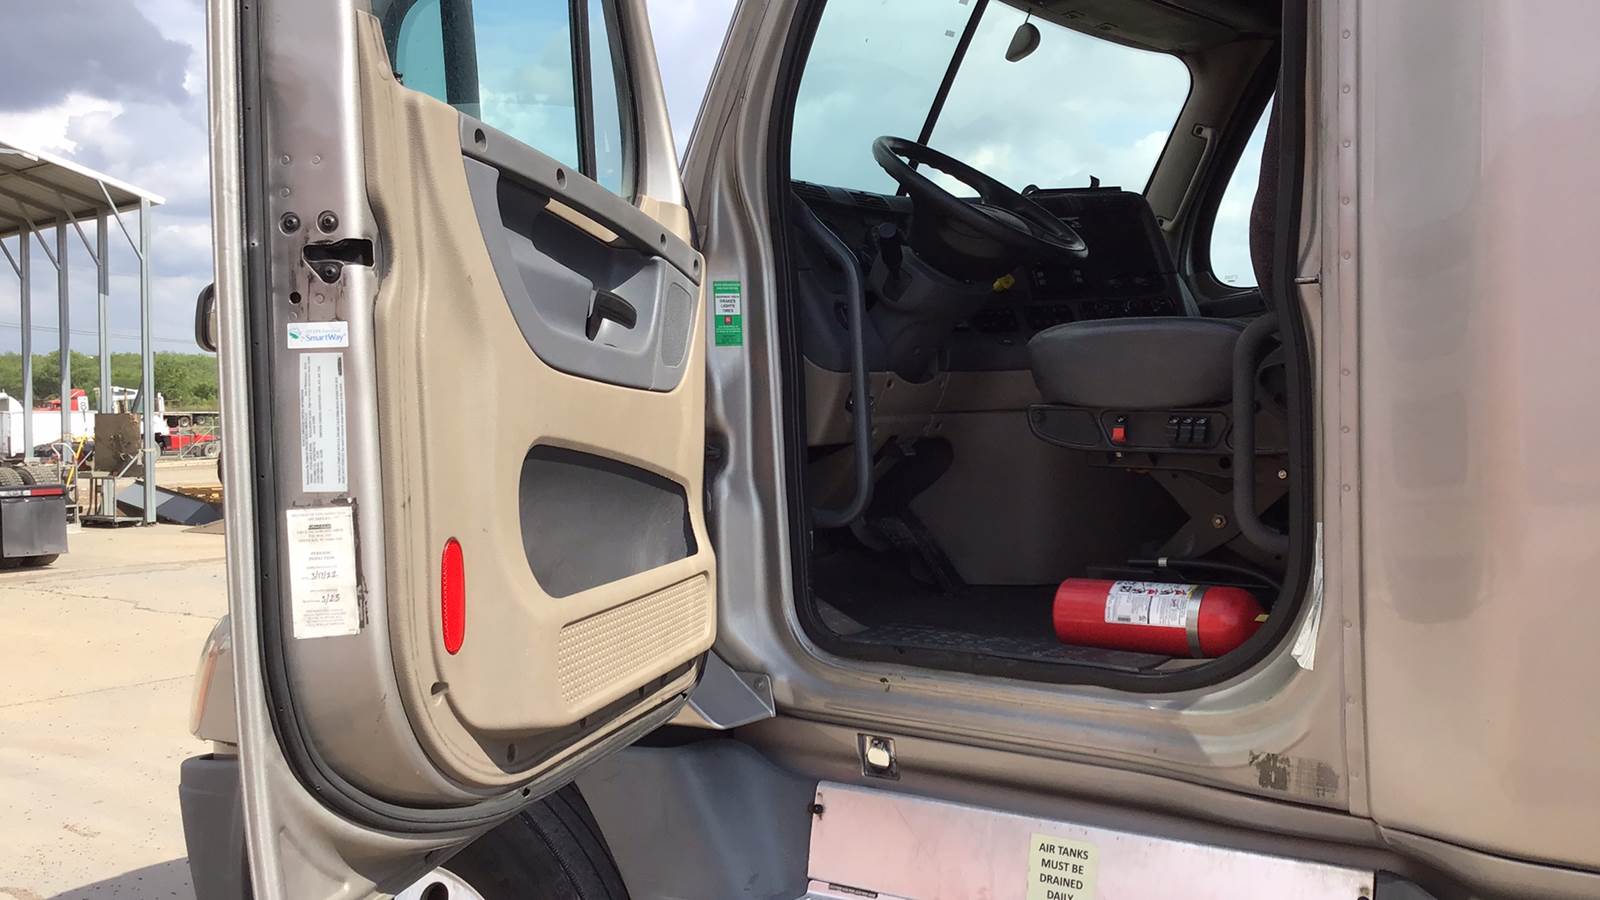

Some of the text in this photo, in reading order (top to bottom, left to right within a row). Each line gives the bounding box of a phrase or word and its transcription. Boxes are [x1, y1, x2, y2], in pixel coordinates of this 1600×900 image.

[304, 333, 344, 343] SmartWay
[1039, 843, 1089, 860] AIR TANKS
[1041, 858, 1084, 875] MUST BE
[1040, 873, 1083, 890] DRAINED
[1047, 890, 1074, 900] DAILY
